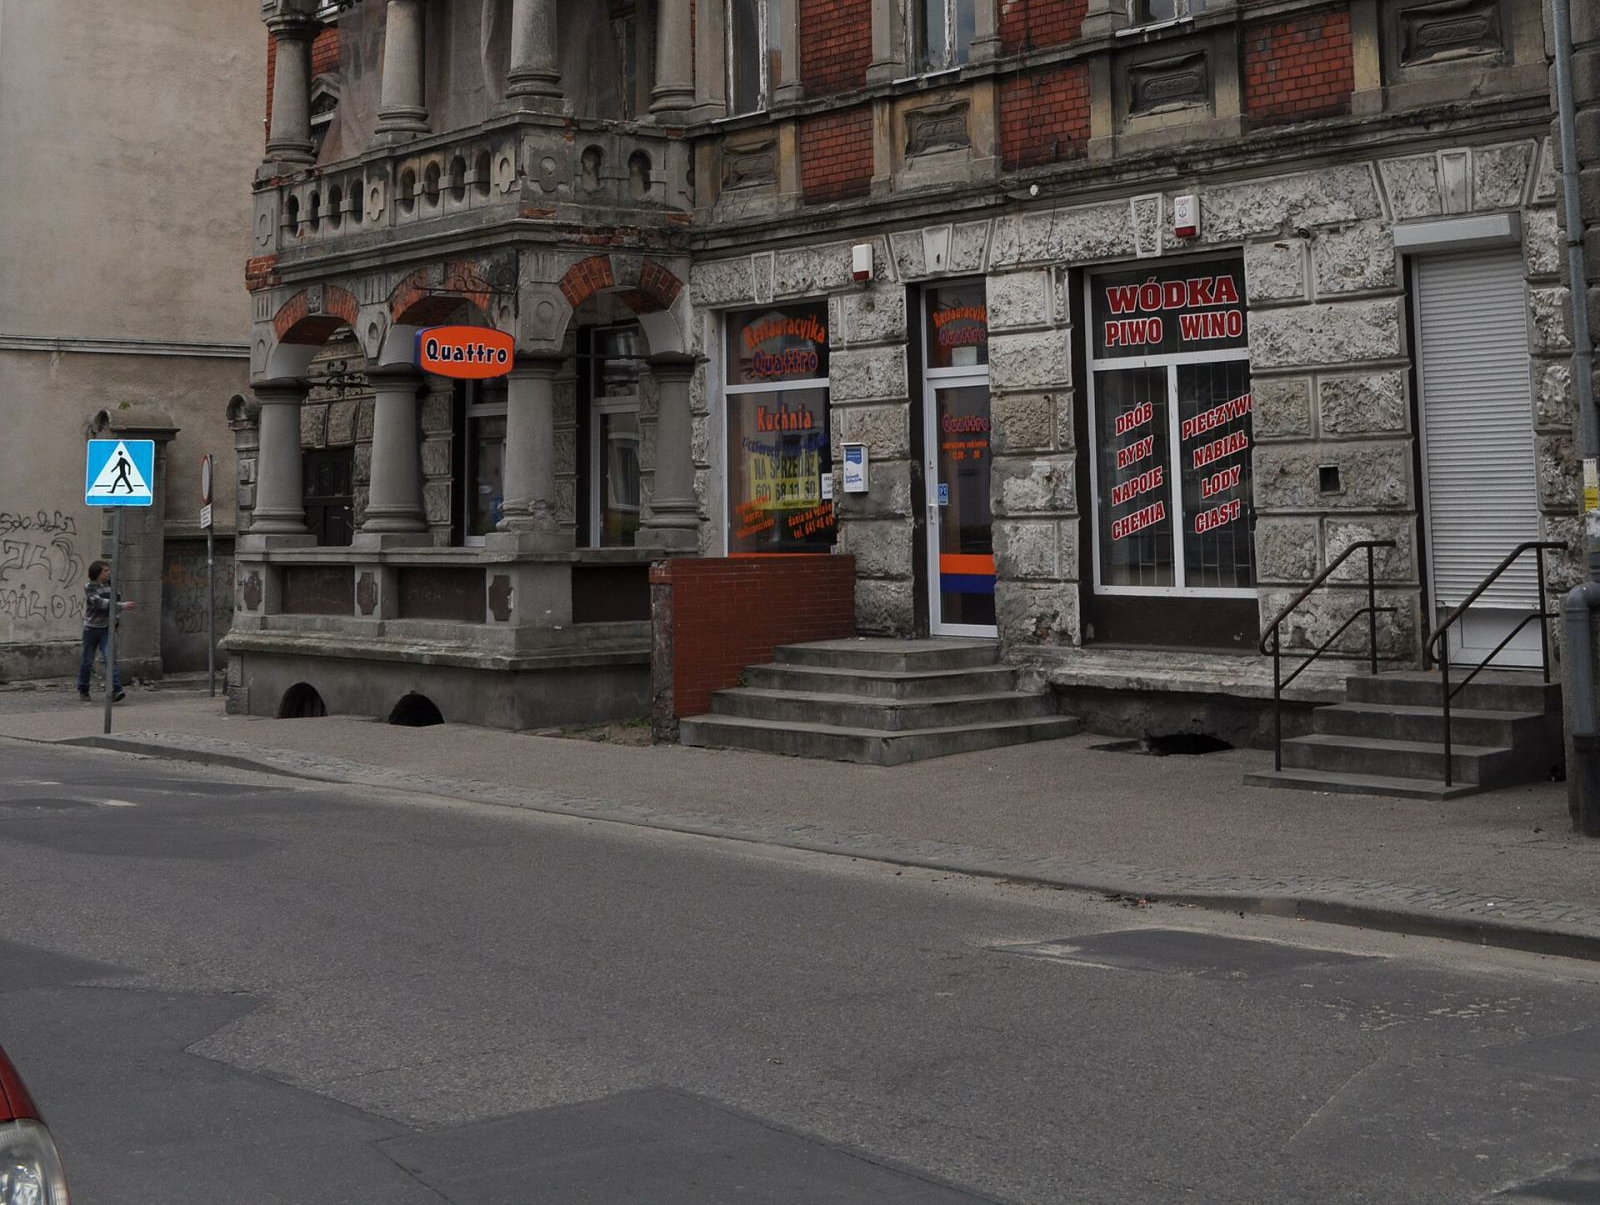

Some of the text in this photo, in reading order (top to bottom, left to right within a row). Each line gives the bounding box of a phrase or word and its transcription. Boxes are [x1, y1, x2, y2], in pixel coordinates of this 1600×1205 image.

[1106, 275, 1239, 314] WÓDKA
[1105, 310, 1243, 347] PIWO WINO
[425, 337, 508, 365] Quattro
[752, 348, 818, 377] Quattro
[756, 404, 812, 432] Kuchnia
[1115, 401, 1153, 436] DRÓB
[1117, 435, 1154, 470] RYBY
[1193, 429, 1248, 470] NABIAŁ
[1112, 465, 1163, 507] NAPOJE
[1201, 464, 1241, 499] LODY
[1112, 500, 1166, 540] CHEMIA
